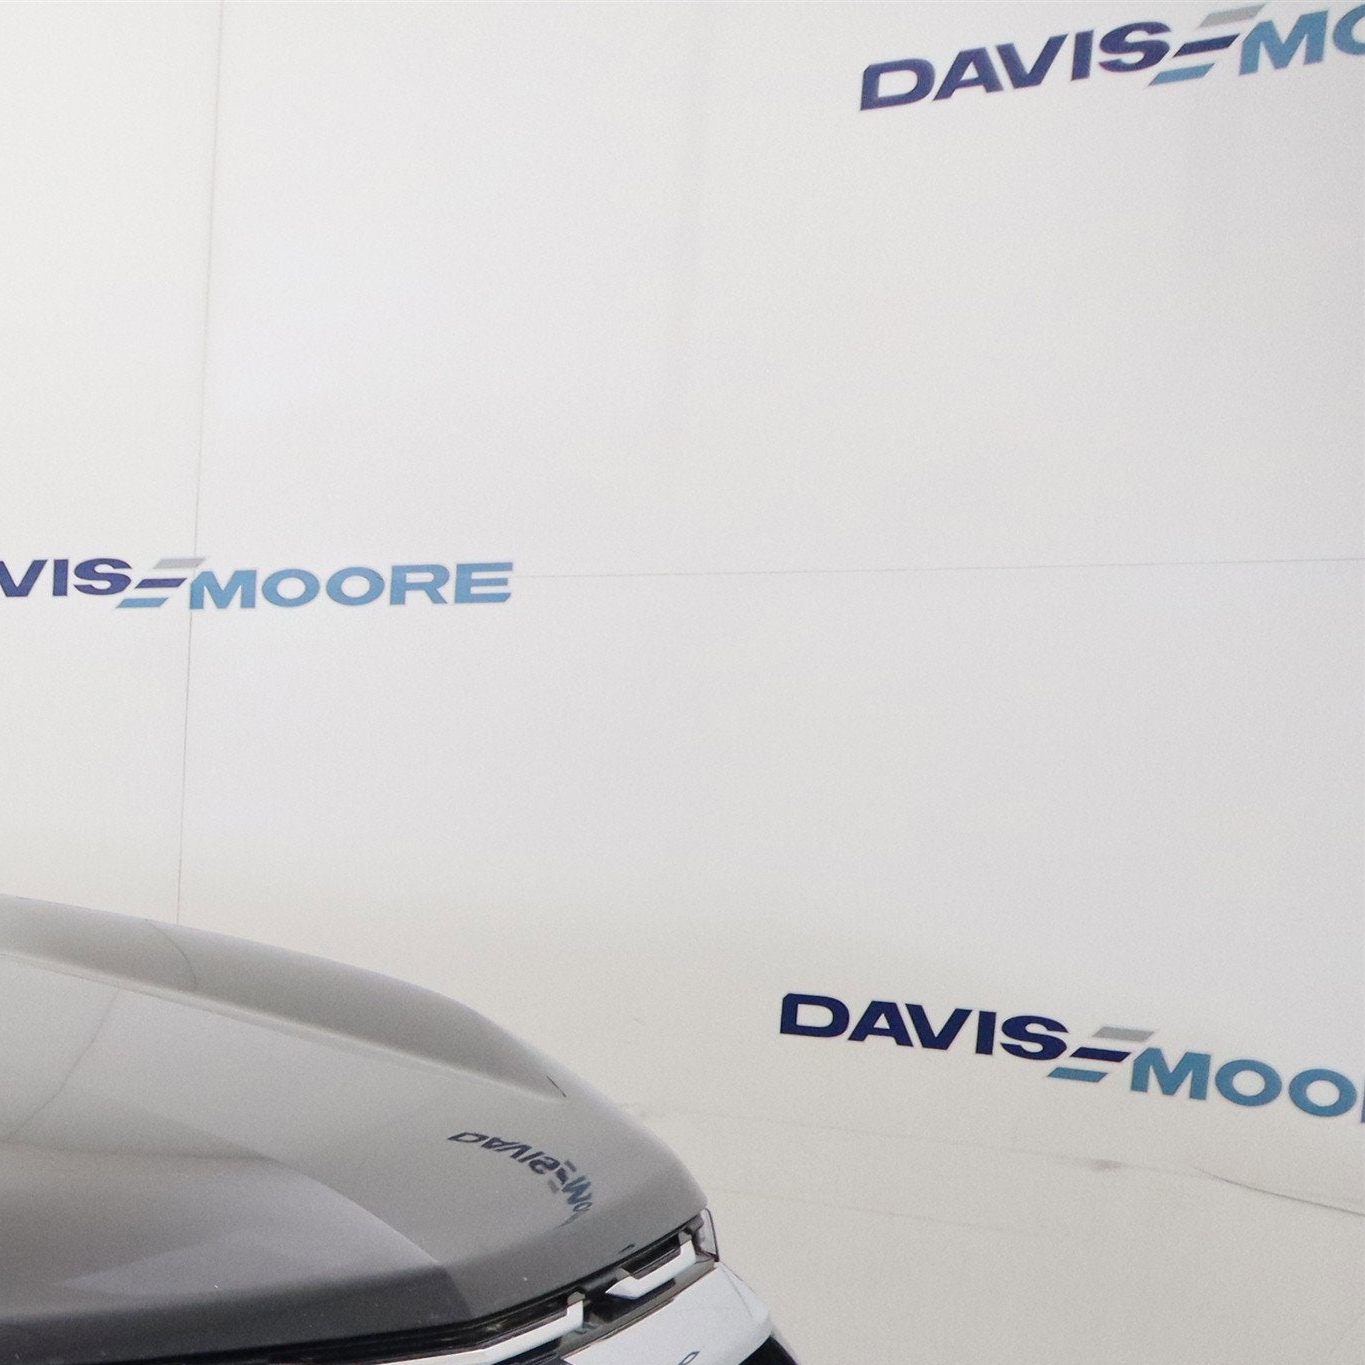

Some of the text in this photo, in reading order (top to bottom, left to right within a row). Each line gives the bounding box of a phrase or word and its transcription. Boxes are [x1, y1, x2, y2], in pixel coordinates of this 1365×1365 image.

[859, 21, 1171, 112] DAVIS
[189, 562, 513, 610] MOORE
[779, 992, 1365, 1123] DAVIS MOO
